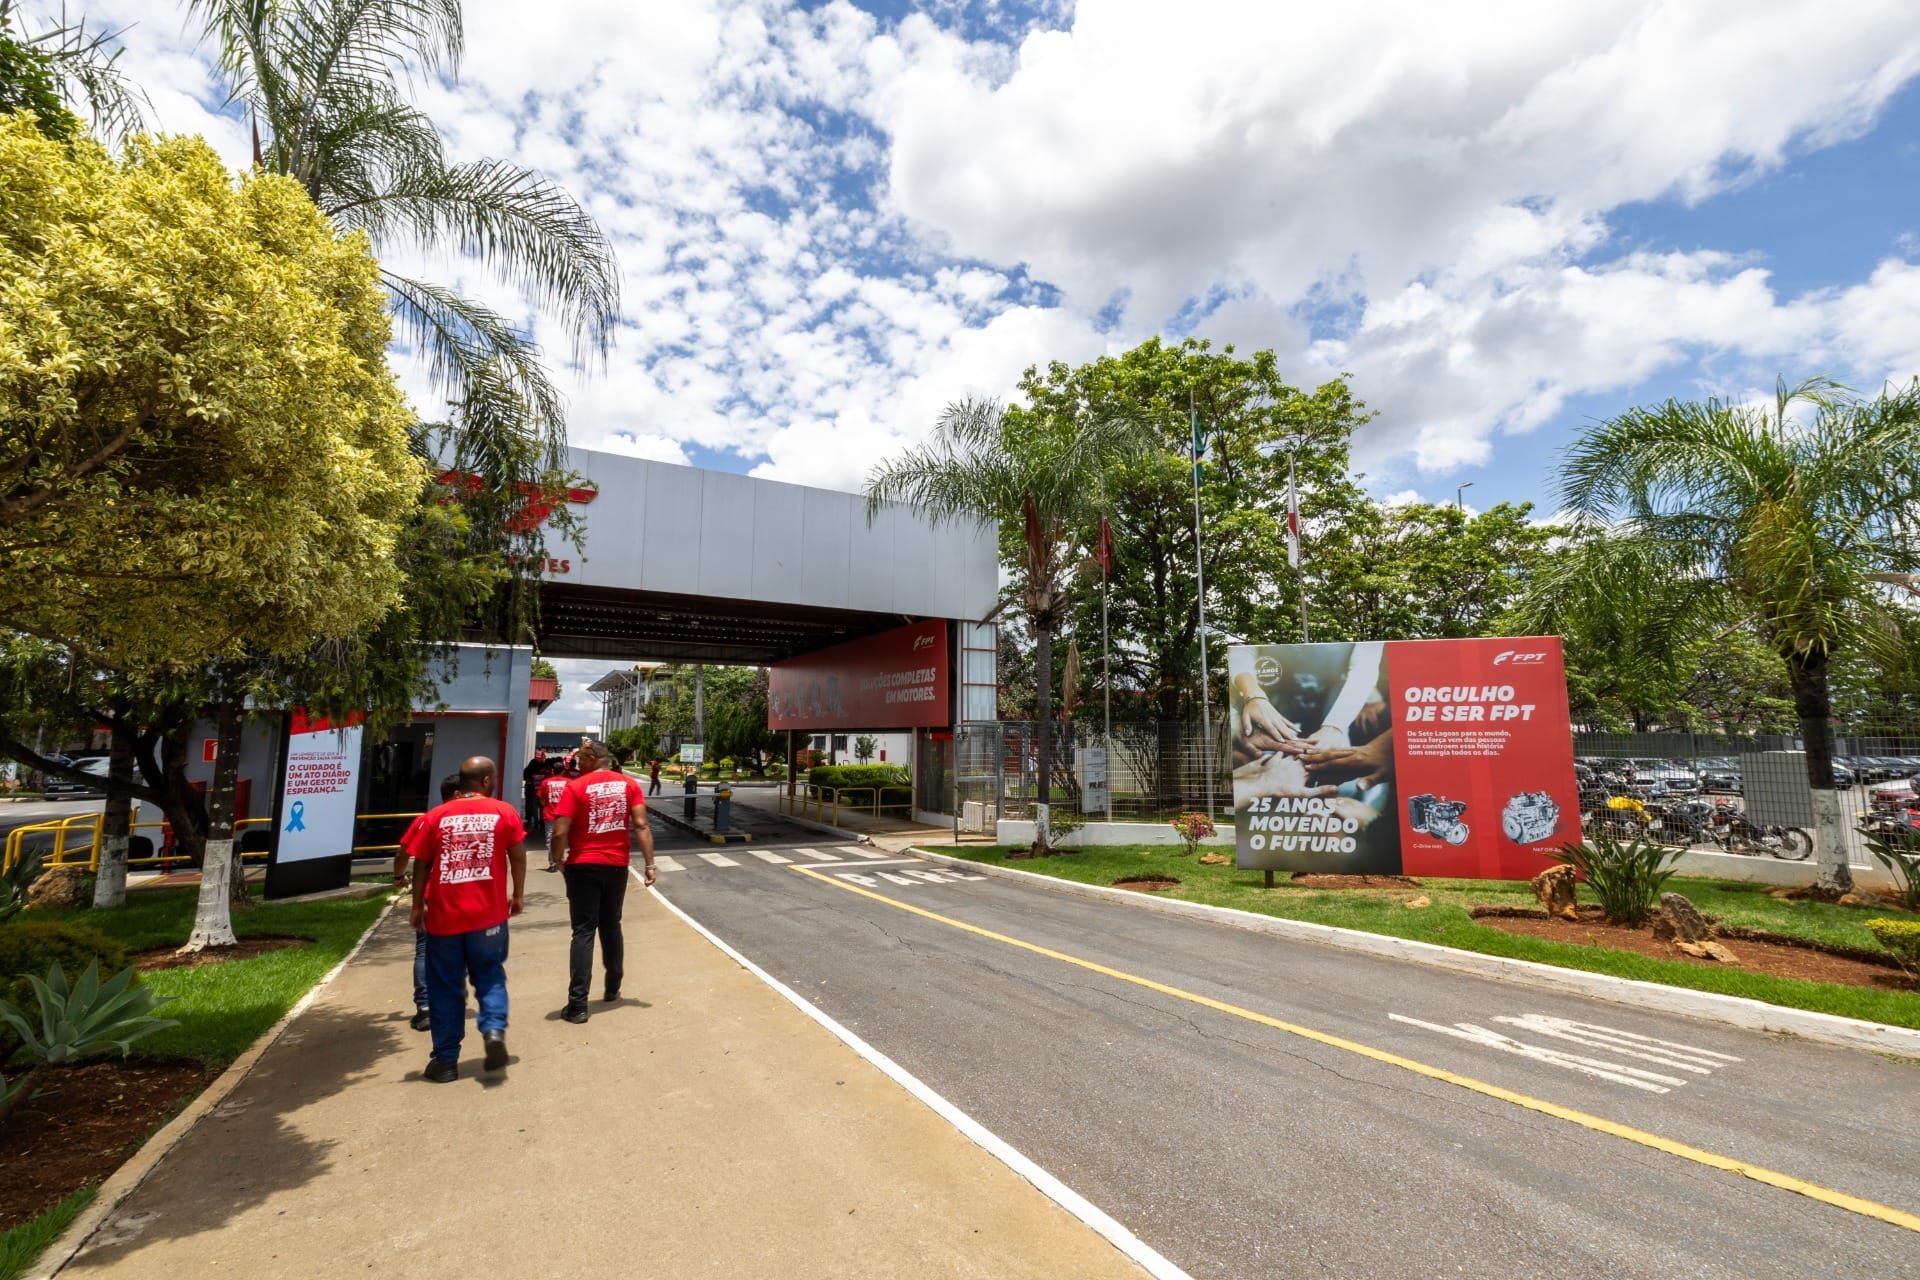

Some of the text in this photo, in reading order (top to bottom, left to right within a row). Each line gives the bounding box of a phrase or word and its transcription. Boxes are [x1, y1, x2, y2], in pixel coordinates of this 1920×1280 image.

[920, 636, 936, 646] FPT
[1512, 653, 1548, 661] FPT
[891, 667, 936, 686] COMPLETAS
[886, 686, 935, 704] EM MOTORES.
[1405, 685, 1515, 702] ORGULHO
[1406, 704, 1536, 721] DE SER FPT
[287, 786, 344, 795] ESPERANÇA...
[1248, 797, 1337, 814] 25 ANOS
[466, 823, 495, 831] ANOS
[1249, 816, 1358, 833] MOVENDO
[1250, 834, 1356, 853] O FUTURO
[450, 854, 472, 862] SETE
[835, 868, 987, 887] PARE
